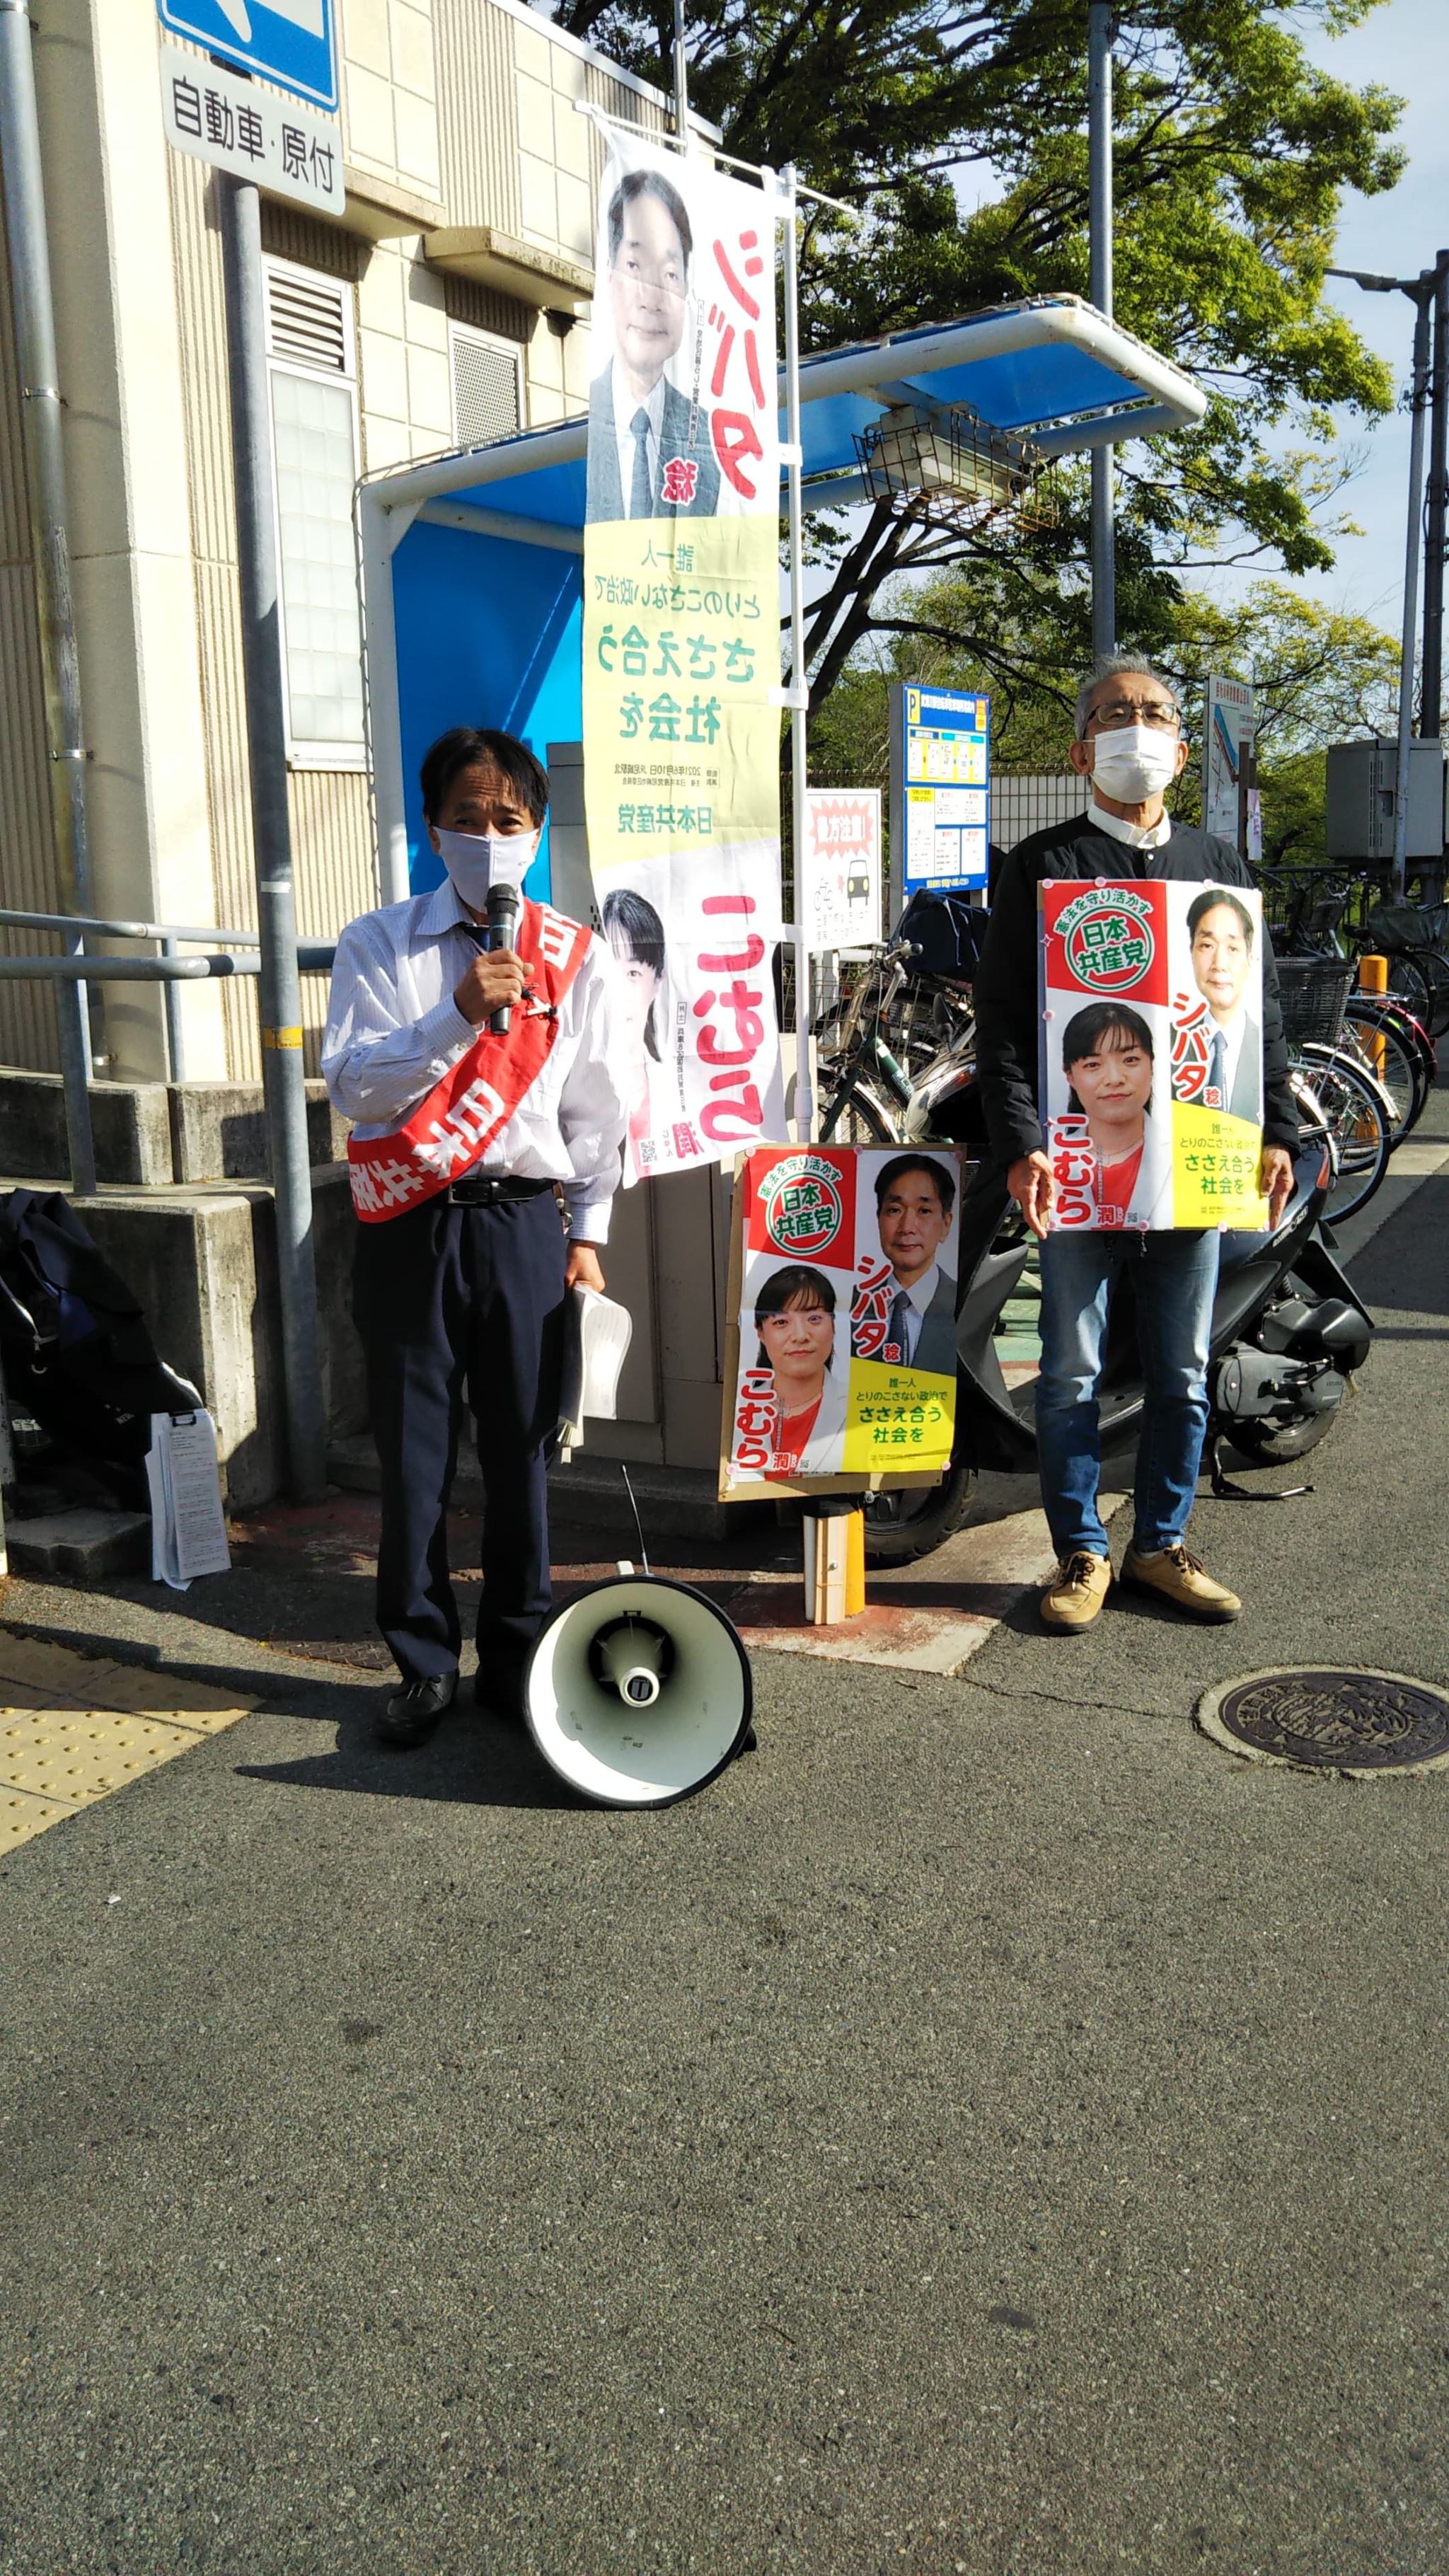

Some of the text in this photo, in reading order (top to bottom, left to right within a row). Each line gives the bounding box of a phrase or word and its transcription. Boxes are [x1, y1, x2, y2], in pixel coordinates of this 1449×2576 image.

[1054, 889, 1153, 935] 憲法を守り活かす
[1083, 916, 1127, 948] 日本
[1077, 944, 1148, 978] 共産党
[1170, 992, 1211, 1101] シバタ
[1204, 1087, 1220, 1107] 稔
[1052, 1114, 1093, 1225] こむら
[1184, 1154, 1254, 1174] ささえ合う
[758, 1157, 844, 1199] 憲法を守り活かす
[1200, 1176, 1244, 1196] 社会を
[780, 1183, 821, 1213] 日本
[775, 1206, 836, 1241] 共産党
[1096, 1206, 1114, 1225] 潤
[852, 1256, 893, 1358] シバタ
[883, 1344, 901, 1362] 稔
[889, 1377, 916, 1390] 誰一人
[856, 1390, 948, 1403] とりのこさない政治で
[737, 1368, 775, 1471] こむら
[859, 1406, 942, 1424] ささえ合う
[872, 1426, 924, 1444] 社会を
[773, 1453, 790, 1470] 潤
